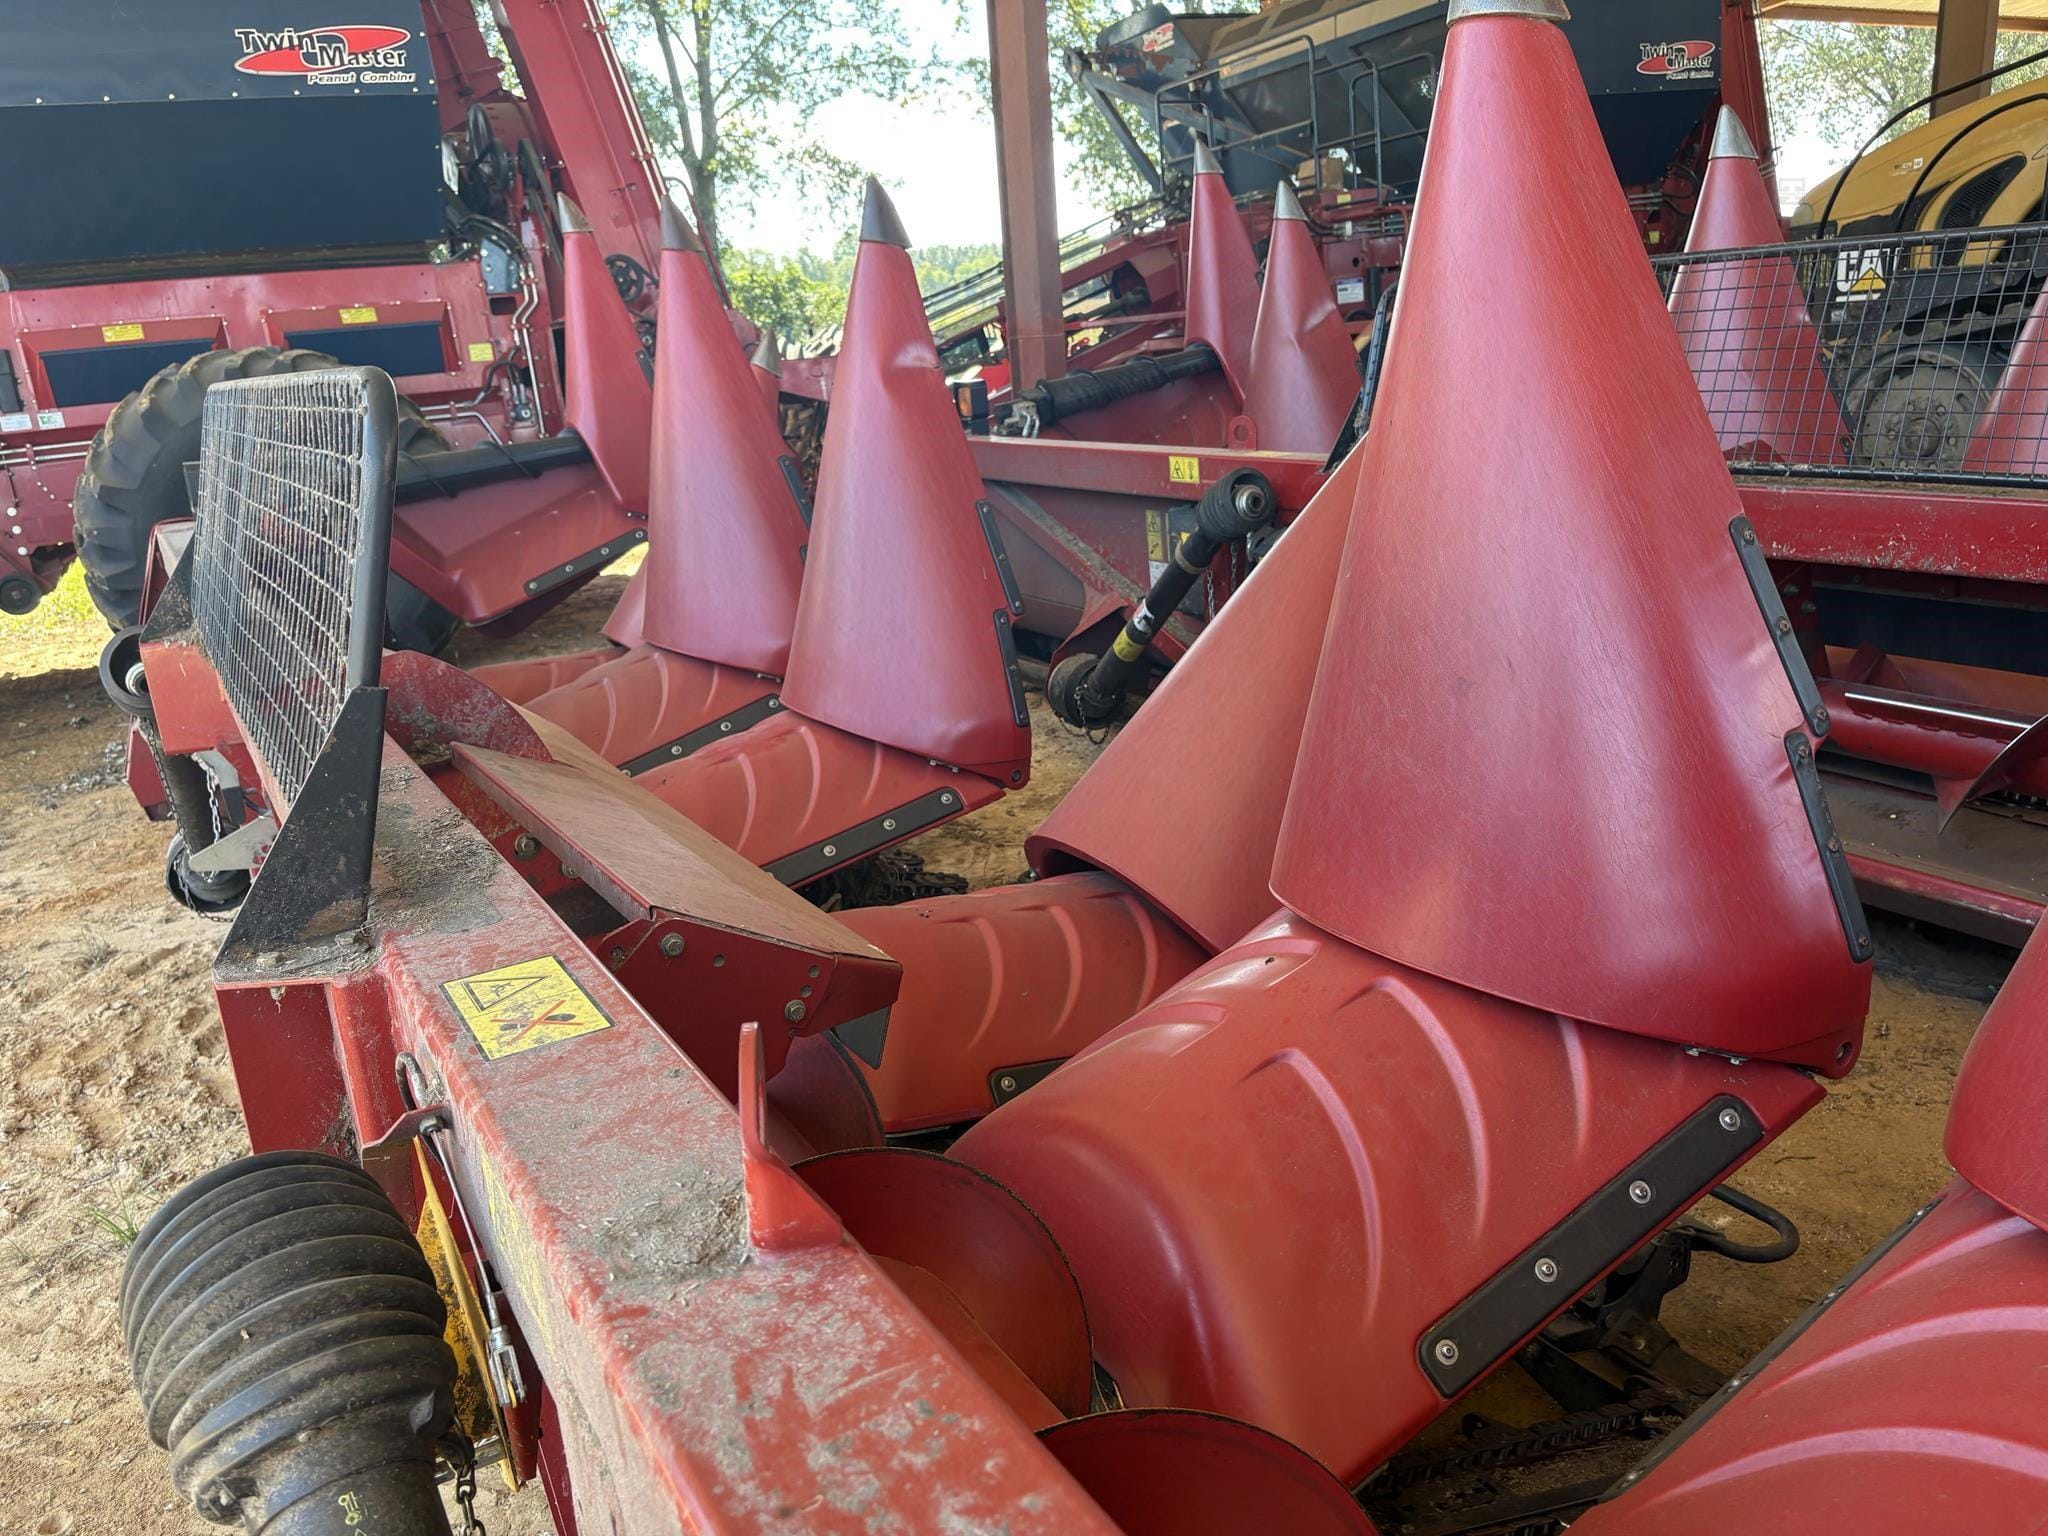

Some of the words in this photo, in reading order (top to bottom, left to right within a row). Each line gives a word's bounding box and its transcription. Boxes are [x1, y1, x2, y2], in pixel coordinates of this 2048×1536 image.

[235, 28, 317, 53] Twin
[317, 43, 407, 67] Master
[1640, 42, 1674, 60] Twin
[1673, 53, 1712, 68] Master
[307, 72, 357, 85] Peanut
